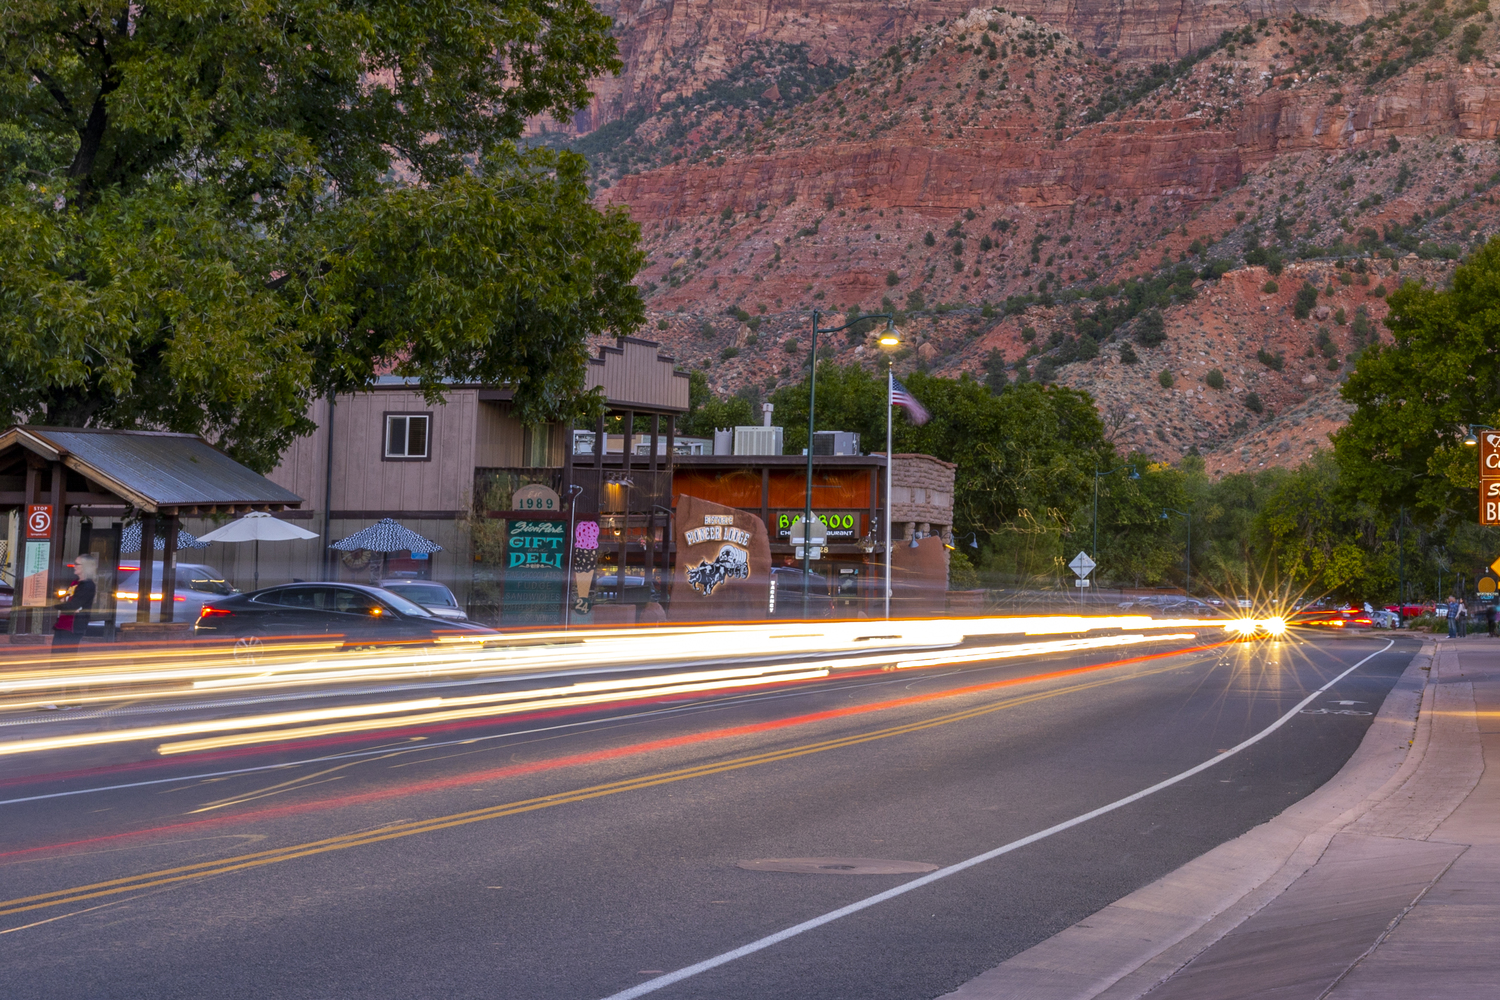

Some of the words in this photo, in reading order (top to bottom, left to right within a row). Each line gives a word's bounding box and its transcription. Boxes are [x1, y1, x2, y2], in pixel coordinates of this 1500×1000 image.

[518, 498, 554, 509] 1989
[35, 515, 45, 529] 5
[779, 514, 854, 529] BABOO
[509, 536, 563, 549] GIFT
[686, 526, 721, 546] PIONEER
[723, 526, 750, 546] LODGE
[509, 552, 563, 569] DELI
[517, 581, 552, 590] FUDGE
[505, 593, 561, 601] SANDWICHES
[575, 598, 589, 614] 24
